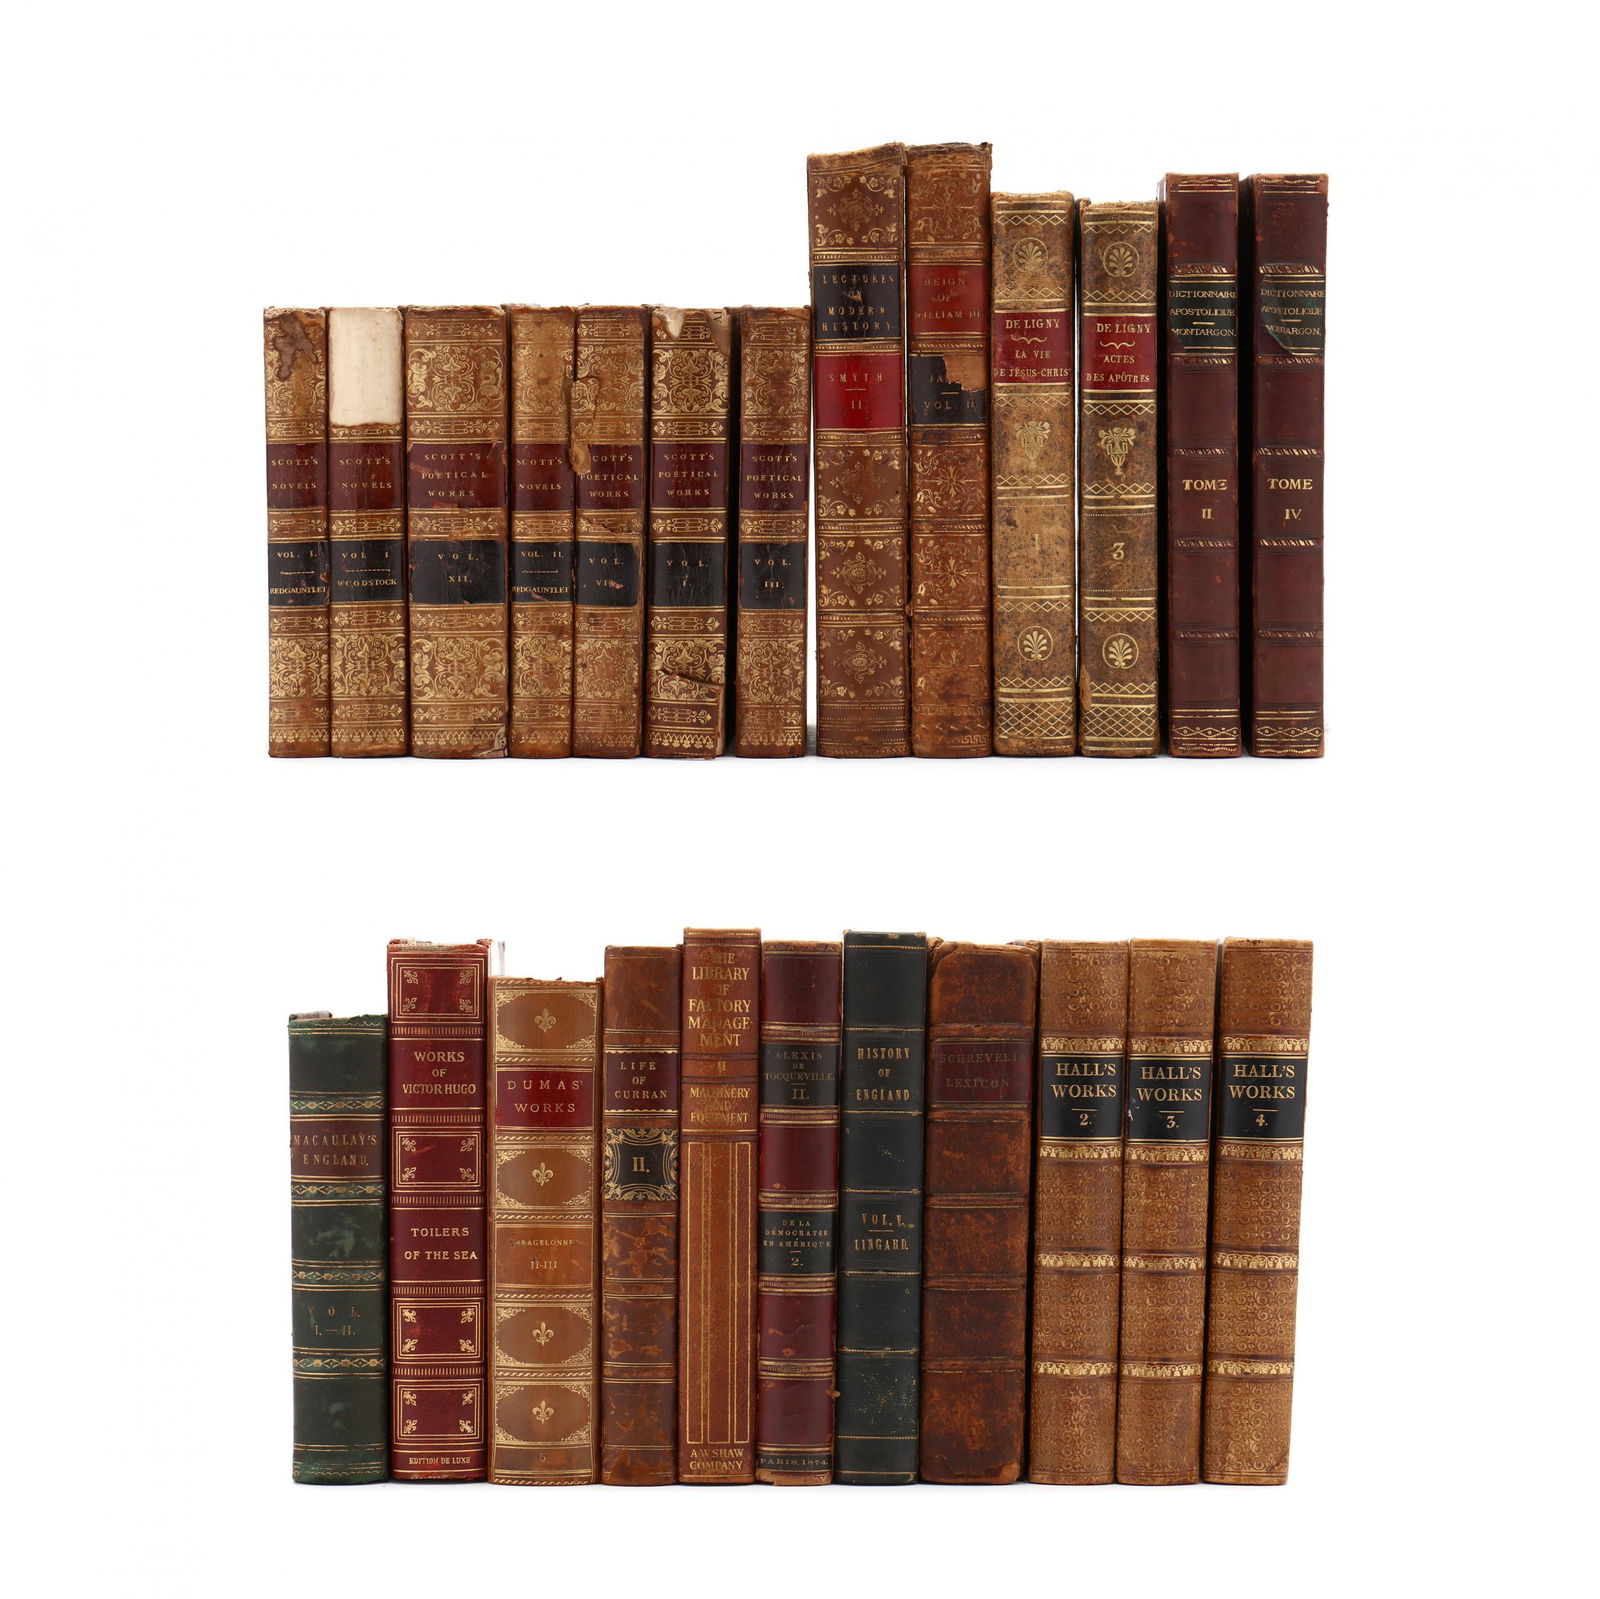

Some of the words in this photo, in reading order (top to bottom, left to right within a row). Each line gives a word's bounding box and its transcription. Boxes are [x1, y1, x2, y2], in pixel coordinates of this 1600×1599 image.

[924, 278, 966, 287] REIGN
[828, 306, 886, 315] MODERN
[914, 311, 963, 319] WILLIAM
[822, 322, 892, 331] HISTORY
[1005, 319, 1019, 329] DE
[1024, 318, 1061, 329] LIGNY
[1096, 323, 1112, 333] DE
[1115, 323, 1152, 334] LIGNY
[1015, 350, 1027, 359] LA
[1033, 350, 1051, 359] VIE
[1103, 354, 1135, 364] ACTES
[829, 373, 883, 382] SMYTH
[1086, 373, 1104, 382] DES
[1108, 372, 1150, 383] APÔTRES
[271, 456, 319, 466] SCOTT'S
[339, 456, 391, 466] SCOTT'S
[424, 452, 481, 461] SCOTT'S
[516, 457, 563, 466] SCOTT'S
[592, 453, 633, 462] COTT'S
[663, 452, 715, 461] SCOTT'S
[752, 453, 798, 462] SCOTT'S
[421, 471, 488, 480] POETICAL
[658, 470, 719, 479] POETICAL
[746, 474, 803, 482] POETICAL
[272, 481, 317, 490] NOVELS
[342, 481, 392, 490] NOVELS
[1182, 479, 1228, 491] TOME
[1267, 478, 1313, 490] TOME
[428, 489, 475, 498] WORKS
[589, 490, 629, 498] WORKS
[667, 488, 710, 497] WORKS
[753, 491, 794, 500] WORKS
[276, 551, 300, 559] VOL.
[520, 551, 544, 559] VOL.
[1112, 542, 1125, 560] 3
[436, 553, 479, 561] VOL.
[588, 557, 624, 565] VOL.
[666, 559, 709, 568] VOL.
[754, 558, 792, 567] VOL.
[448, 575, 473, 584] XII.
[414, 1051, 465, 1063] WORKS
[774, 1051, 823, 1061] ALEXIS
[857, 1047, 911, 1060] HISTORY
[620, 1061, 657, 1071] LIFE
[1055, 1062, 1117, 1077] HALL'S
[1233, 1063, 1296, 1078] HALL'S
[432, 1068, 448, 1078] OF
[877, 1068, 892, 1078] OF
[1140, 1066, 1202, 1080] HALL'S
[507, 1080, 584, 1090] DUMAS'
[632, 1076, 647, 1085] OF
[945, 1077, 1010, 1088] LEXICON
[402, 1084, 442, 1095] VICTOR
[444, 1084, 477, 1095] HUGO
[614, 1090, 668, 1099] CURRAN
[791, 1088, 810, 1101] II.
[1051, 1084, 1118, 1098] WORKS
[1228, 1085, 1296, 1099] WORKS
[856, 1089, 911, 1101] ENGLAND
[1136, 1088, 1203, 1102] WORKS
[514, 1103, 576, 1113] WORKS
[1079, 1113, 1092, 1126] 2.
[1166, 1115, 1180, 1129] 3.
[1255, 1114, 1268, 1127] 4.
[293, 1134, 377, 1147] MACAULAY'S
[303, 1153, 369, 1167] ENGLAND.
[632, 1156, 651, 1173] II.
[782, 1219, 795, 1227] DE
[799, 1219, 811, 1227] LA
[861, 1213, 893, 1226] VOL.
[410, 1227, 470, 1238] TOILERS
[765, 1226, 830, 1237] DÉMOCRATIE
[763, 1240, 774, 1248] EN
[778, 1238, 832, 1248] AMÉRIQUE
[854, 1238, 909, 1251] LINGARD.
[404, 1251, 420, 1260] OF
[425, 1251, 450, 1260] THE
[453, 1251, 478, 1260] SEA
[791, 1257, 804, 1267] 2.
[712, 1448, 745, 1458] SHAW
[408, 1457, 439, 1465] EDITION
[440, 1457, 451, 1465] DE
[452, 1456, 472, 1464] LUXE
[689, 1460, 743, 1470] COMPANY
